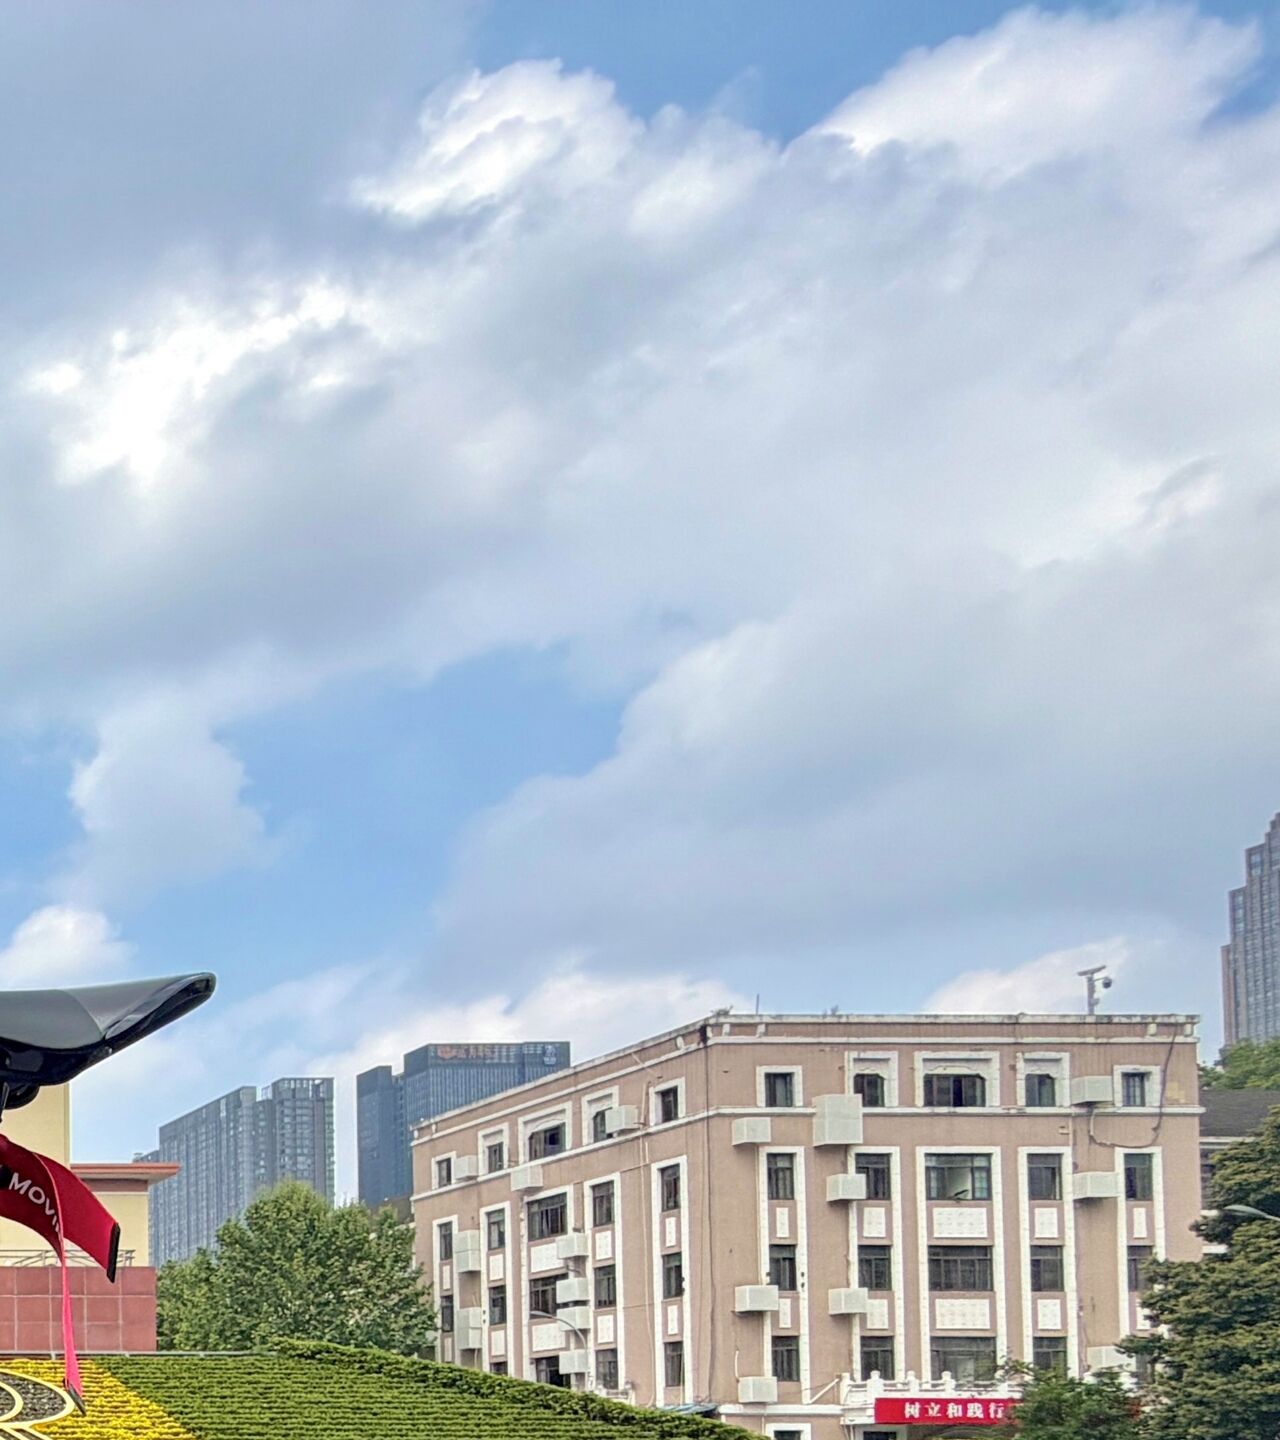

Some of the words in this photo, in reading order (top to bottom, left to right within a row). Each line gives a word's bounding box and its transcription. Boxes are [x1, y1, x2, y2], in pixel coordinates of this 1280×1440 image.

[903, 1401, 1006, 1420] 树立和践行
